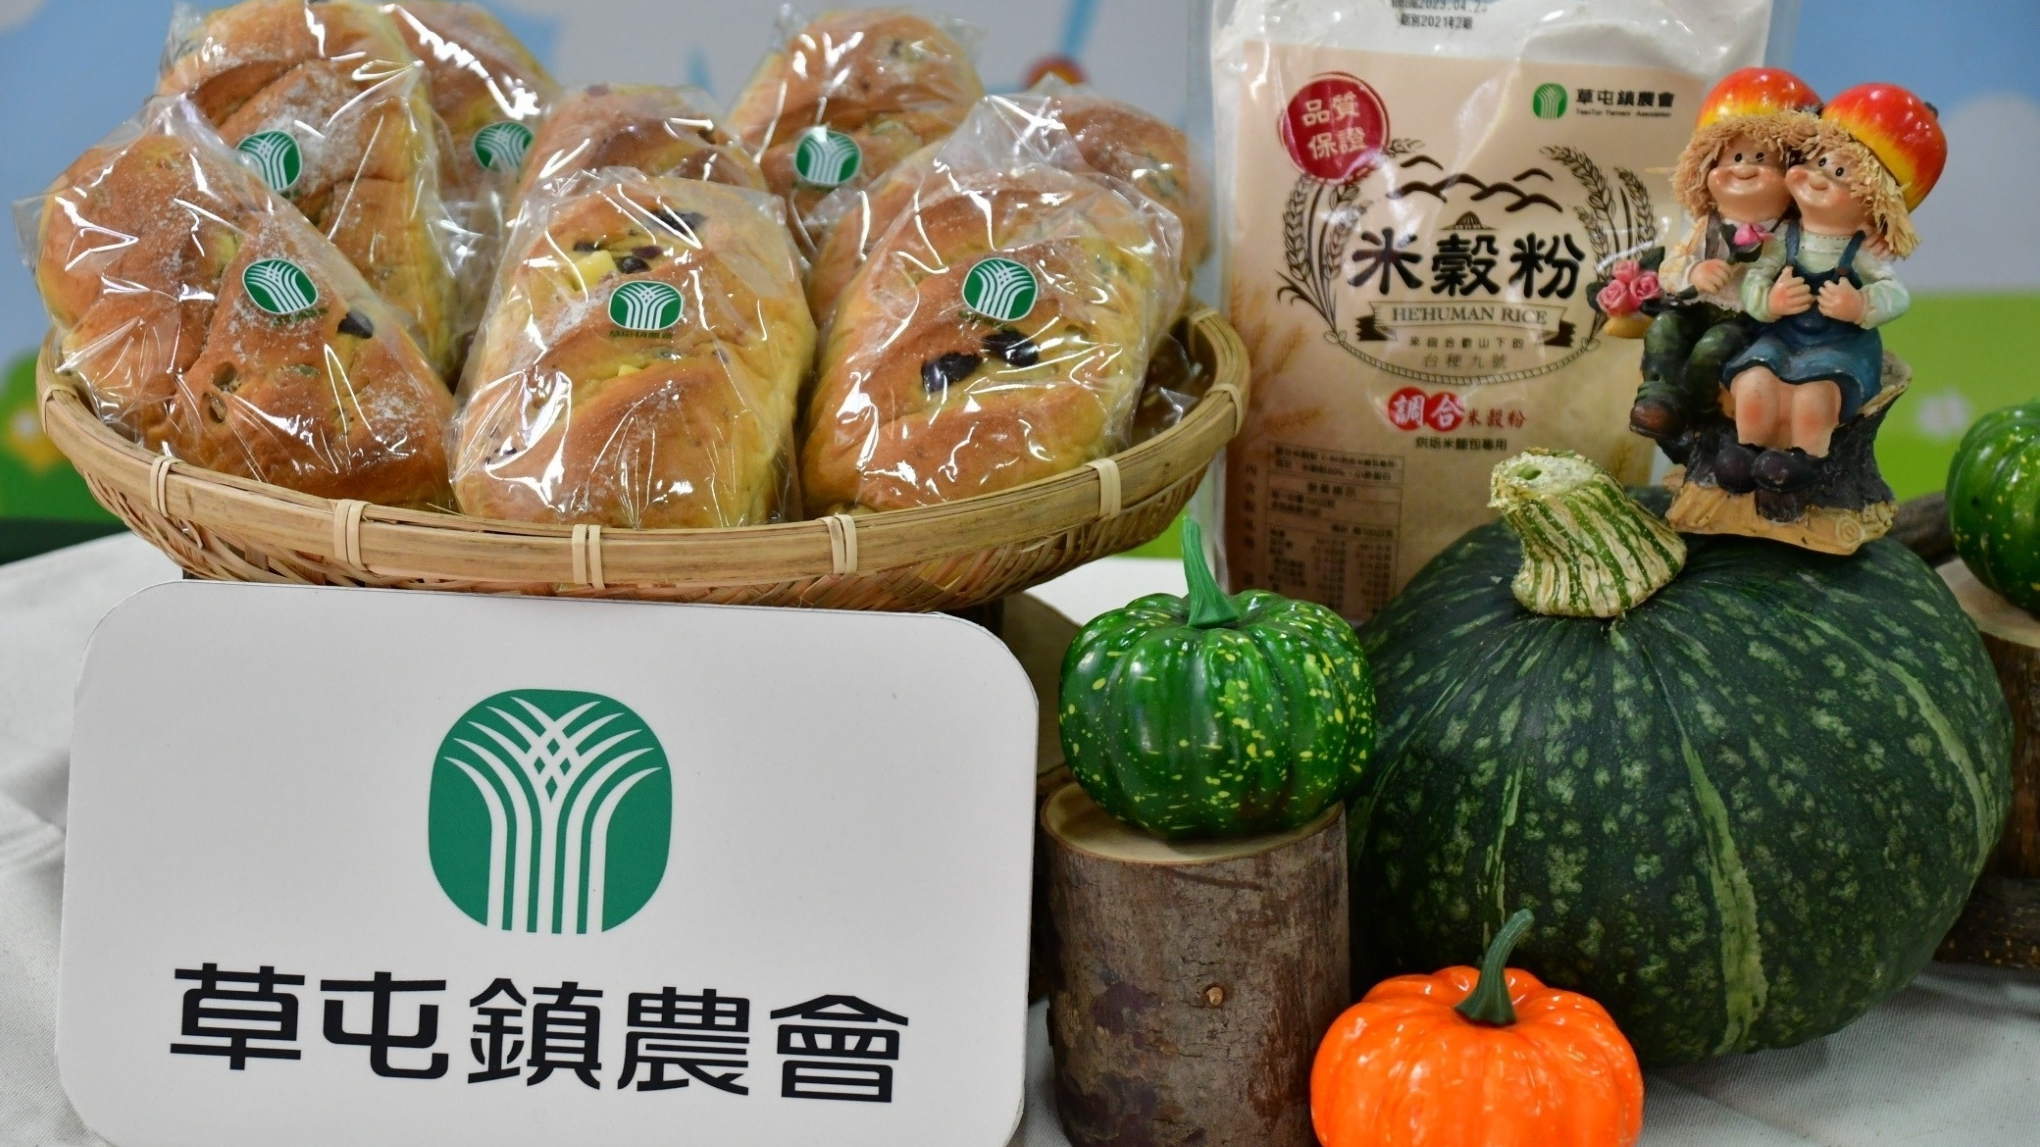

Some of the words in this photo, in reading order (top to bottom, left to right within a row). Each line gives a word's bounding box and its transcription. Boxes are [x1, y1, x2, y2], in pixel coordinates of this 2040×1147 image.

[1302, 91, 1360, 127] 品質
[1576, 88, 1675, 108] 草屯鎮農會
[1307, 126, 1367, 160] 保證
[1348, 227, 1586, 299] 米穀粉
[1501, 308, 1548, 325] RICE
[171, 963, 909, 1104] 草屯鎮農會
